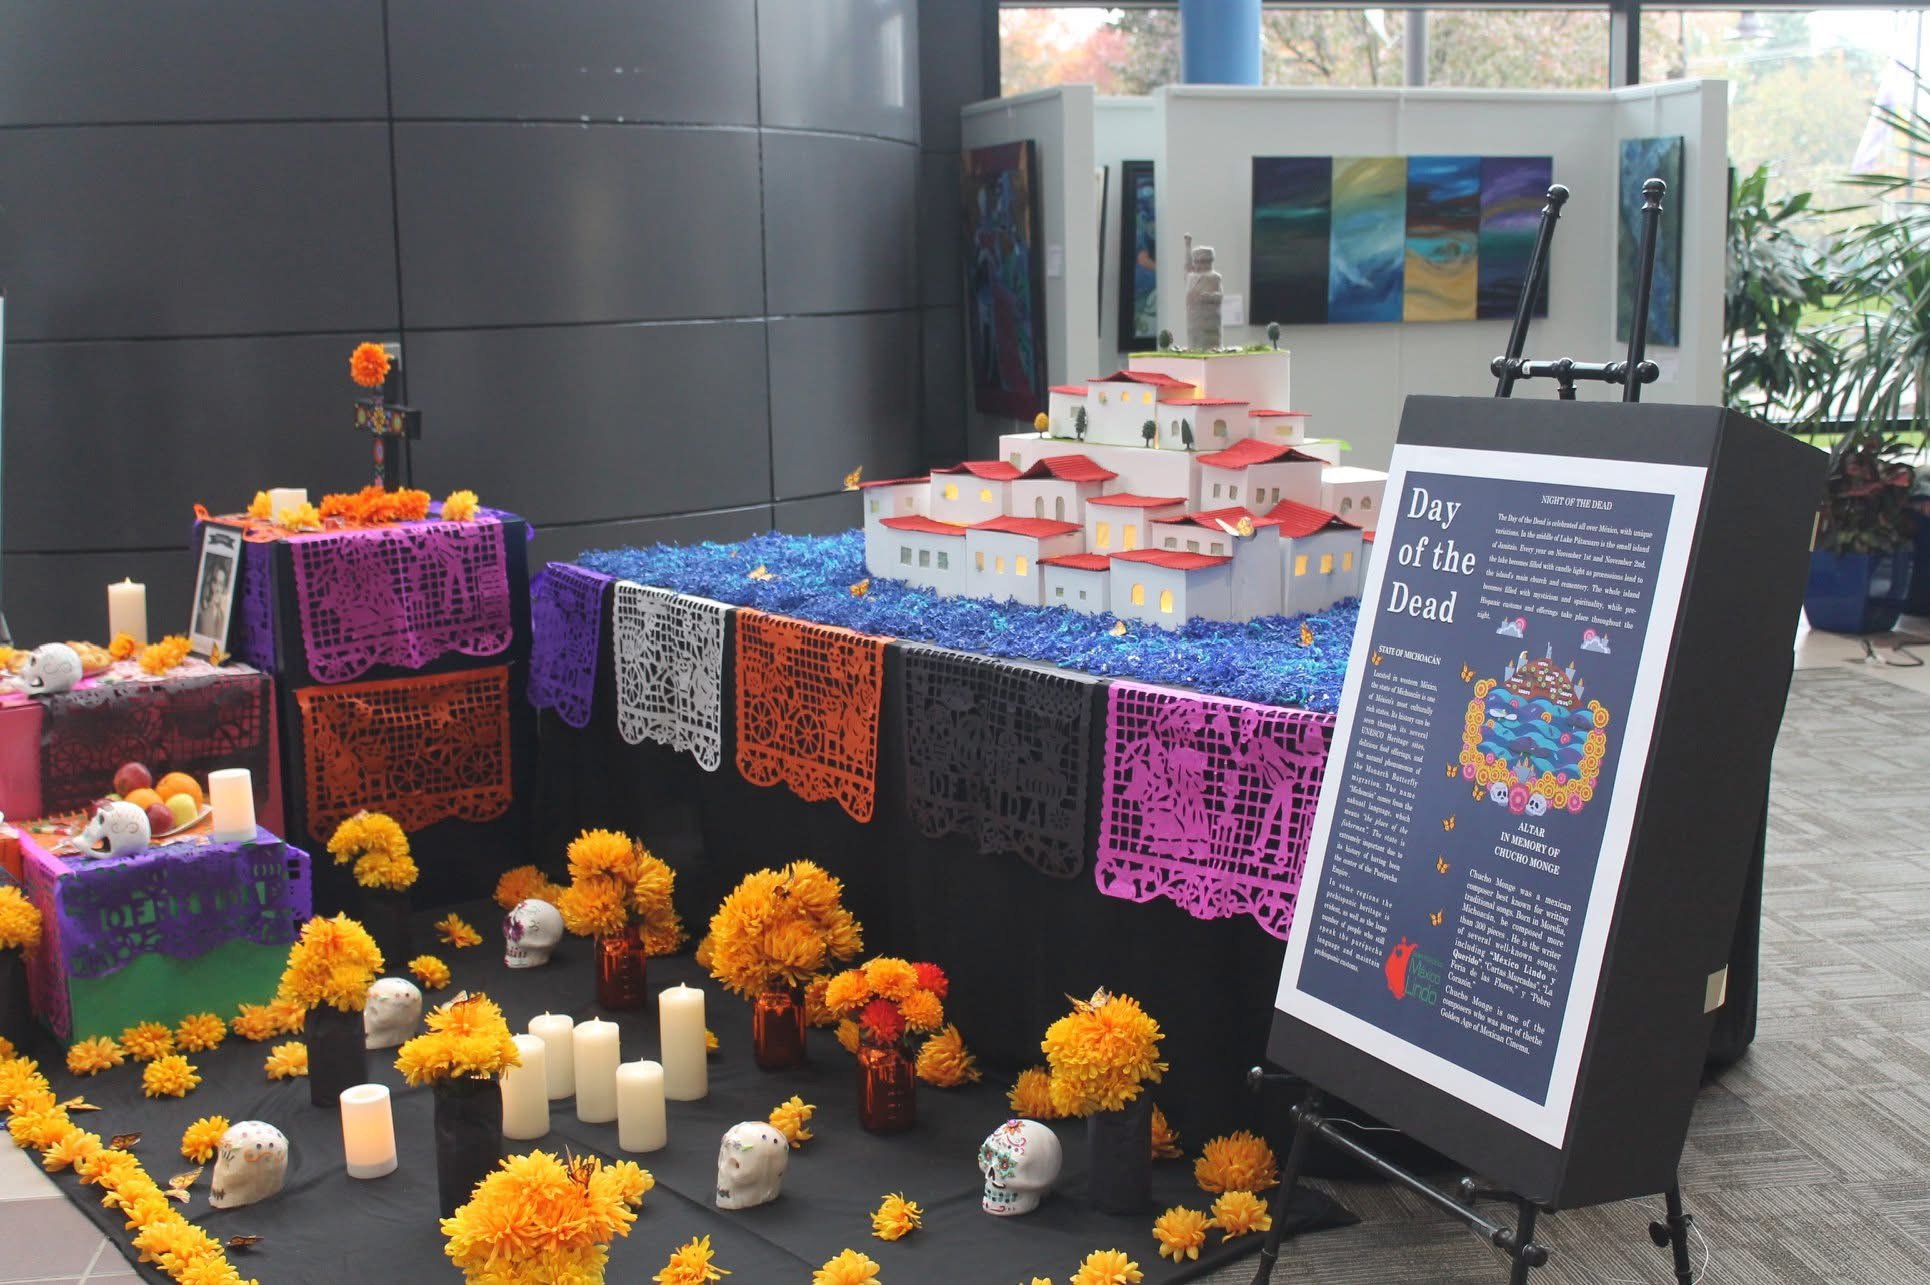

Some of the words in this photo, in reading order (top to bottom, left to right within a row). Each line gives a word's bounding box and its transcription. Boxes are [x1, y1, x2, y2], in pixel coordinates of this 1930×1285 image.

[1407, 487, 1461, 529] Day
[1541, 495, 1565, 505] NIGHT
[1565, 498, 1576, 506] OF
[1576, 498, 1591, 508] THE
[1591, 500, 1613, 510] DEAD
[1399, 536, 1429, 567] of
[1433, 540, 1476, 575] the
[1387, 581, 1457, 623] Dead
[1378, 645, 1395, 655] STATE
[1395, 649, 1404, 657] OF
[1500, 832, 1511, 842] IN
[1511, 835, 1547, 854] MEMORY
[1548, 847, 1560, 858] OF
[1518, 822, 1545, 838] ALTAR
[1494, 846, 1528, 864] CHUCHO
[1529, 857, 1560, 875] MONGE
[1467, 883, 1494, 897] composer
[1496, 890, 1509, 903] best
[1511, 896, 1531, 911] known
[1534, 904, 1544, 915] for
[1546, 911, 1569, 926] writing
[1469, 869, 1492, 883] Chucho
[1495, 877, 1516, 892] Monge
[1520, 888, 1532, 897] was
[1545, 897, 1571, 911] mexican
[1464, 893, 1496, 910] traditional
[1516, 910, 1531, 923] Born
[1532, 916, 1539, 926] in
[1457, 927, 1465, 935] of
[1467, 932, 1491, 945] several
[1460, 915, 1473, 927] than
[1475, 921, 1486, 931] 300
[1487, 926, 1505, 939] pieces
[1511, 934, 1520, 945] He
[1522, 938, 1527, 947] is
[1529, 941, 1540, 952] the
[1542, 948, 1562, 960] writer
[1500, 916, 1508, 927] he
[1512, 924, 1543, 940] composed
[1547, 936, 1564, 948] more
[1450, 959, 1466, 973] Feria
[1470, 968, 1477, 977] de
[1481, 972, 1490, 983] las
[1455, 937, 1486, 958] including
[1524, 964, 1546, 980] Lindo
[1550, 978, 1556, 986] y
[1440, 1008, 1460, 1023] Golden
[1460, 1017, 1472, 1029] Age
[1473, 1023, 1480, 1032] of
[1479, 1024, 1504, 1043] Mexican
[1442, 998, 1472, 1015] composers
[1474, 1011, 1485, 1021] who
[1487, 1017, 1498, 1027] was
[1499, 1023, 1513, 1033] part
[1514, 1028, 1522, 1037] of
[1445, 985, 1468, 1001] Chucho
[1472, 996, 1493, 1012] Monge
[1497, 1006, 1503, 1016] is
[1507, 1013, 1519, 1023] one
[1523, 1019, 1531, 1028] of
[1534, 1023, 1545, 1034] the
